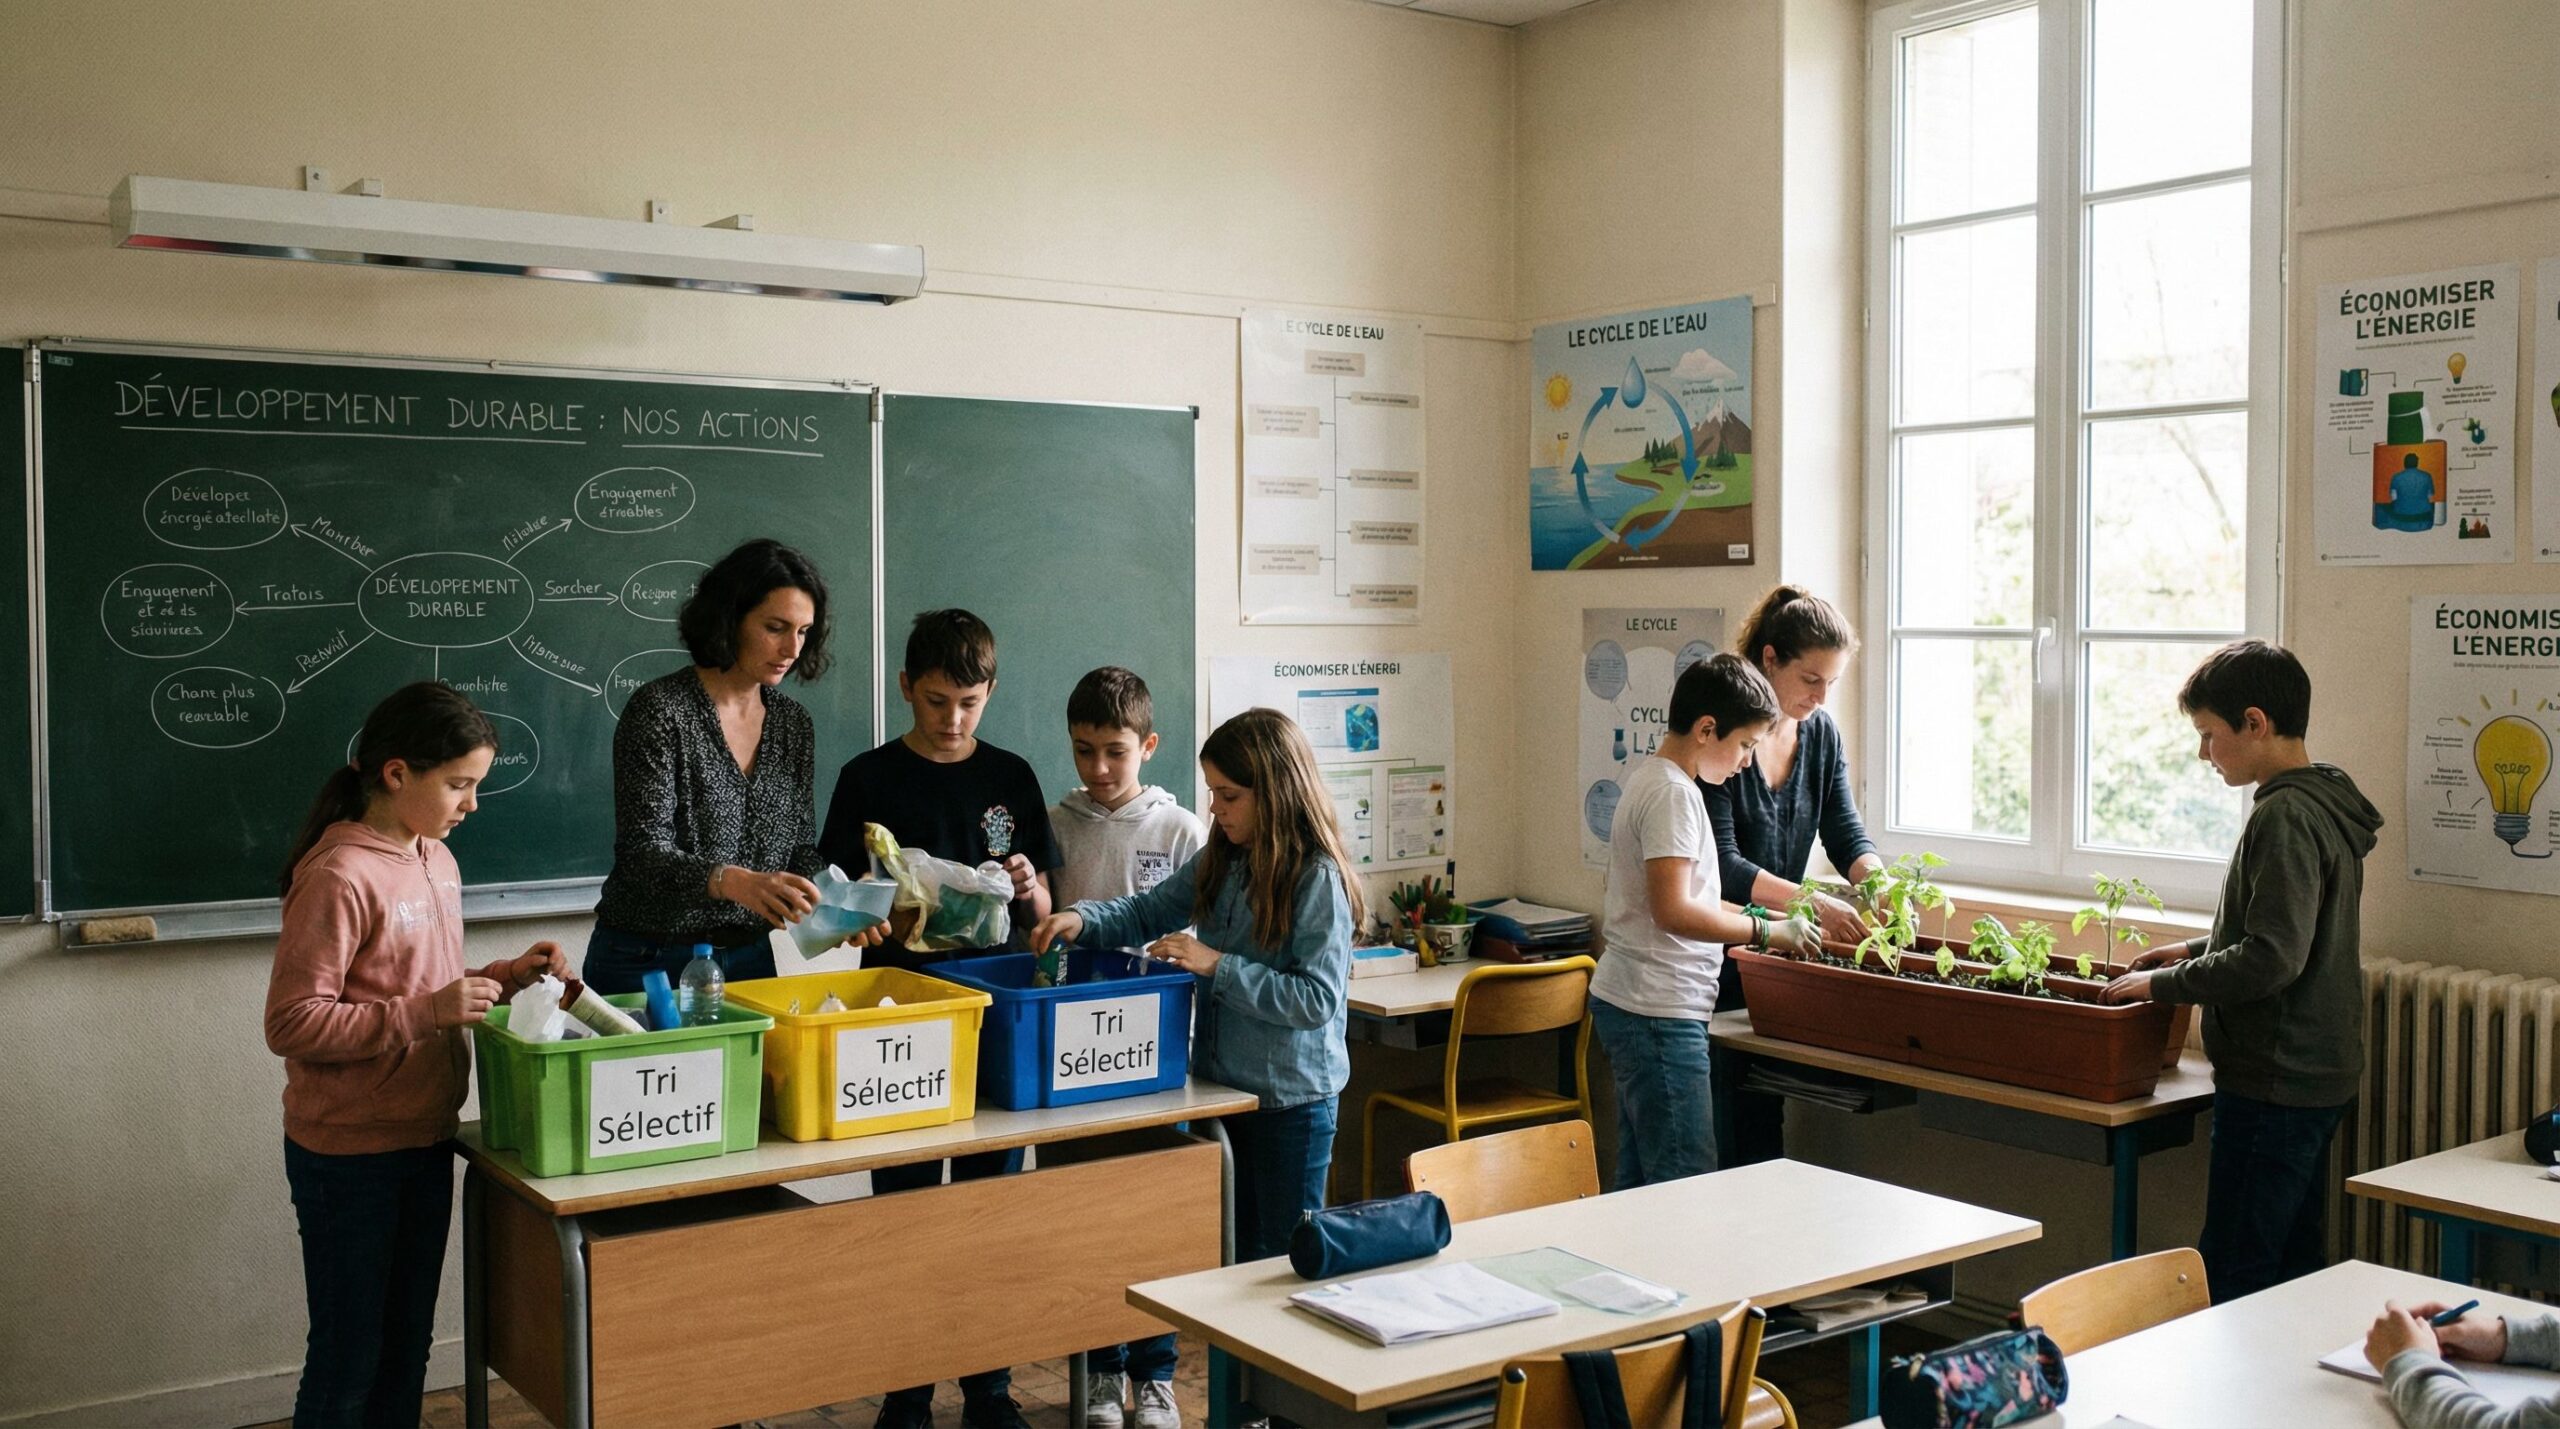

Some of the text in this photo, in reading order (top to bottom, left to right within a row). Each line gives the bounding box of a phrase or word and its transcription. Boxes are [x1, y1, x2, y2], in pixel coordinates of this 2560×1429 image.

[2340, 279, 2495, 316] ÉCONOMISER
[1296, 321, 1334, 336] CYCLE
[1336, 324, 1351, 337] DE
[1354, 325, 1384, 340] L'EAU
[1568, 312, 1707, 348] LE CYCLE DE L'EAU
[2356, 307, 2476, 340] L'ÉNERGIE
[114, 372, 421, 426] DÉVELOPPEMENT
[448, 398, 585, 432] DURABLE
[623, 406, 681, 436] NOS
[699, 408, 820, 443] ACTIONS
[375, 572, 520, 595] DÉVELOPPEMENT
[545, 578, 602, 595] Sorcher
[407, 601, 487, 618] DURABLE
[1626, 617, 1678, 631] LE CYCLE
[1274, 661, 1349, 677] ÉCONOMISER
[1091, 1008, 1124, 1036] Tri
[876, 1035, 913, 1064] Tri
[1060, 1042, 1154, 1077] Sélectif
[636, 1066, 678, 1098] Tri
[842, 1069, 946, 1109] Sélectif
[598, 1102, 716, 1145] Sélectif
